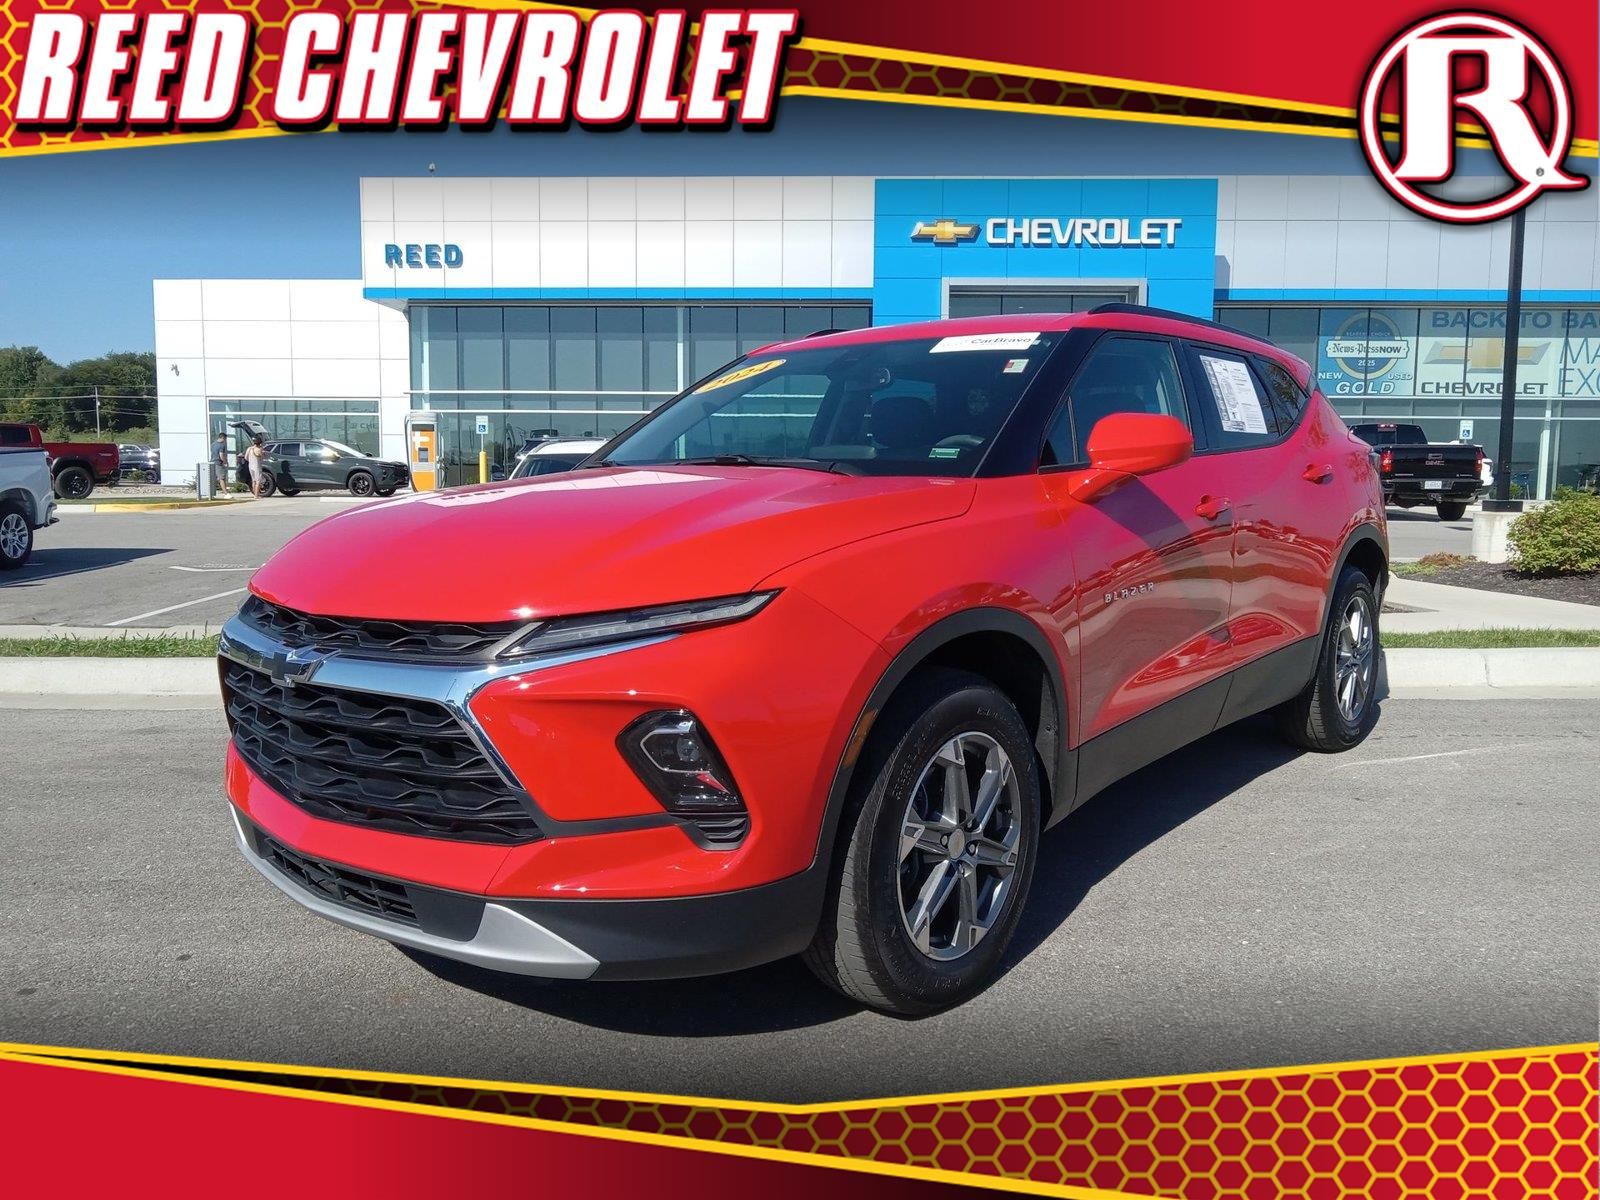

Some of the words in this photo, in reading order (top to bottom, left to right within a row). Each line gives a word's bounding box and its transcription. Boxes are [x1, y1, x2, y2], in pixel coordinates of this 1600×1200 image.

[986, 217, 1183, 247] CHEVROLET
[384, 243, 464, 269] REED
[1431, 311, 1505, 328] BACK
[1520, 311, 1552, 328] TO
[1561, 312, 1600, 328] BA
[970, 336, 1032, 345] CarBravo
[1318, 372, 1343, 380] NEW
[1335, 381, 1395, 394] GOLD
[1104, 582, 1154, 603] BLAZER
